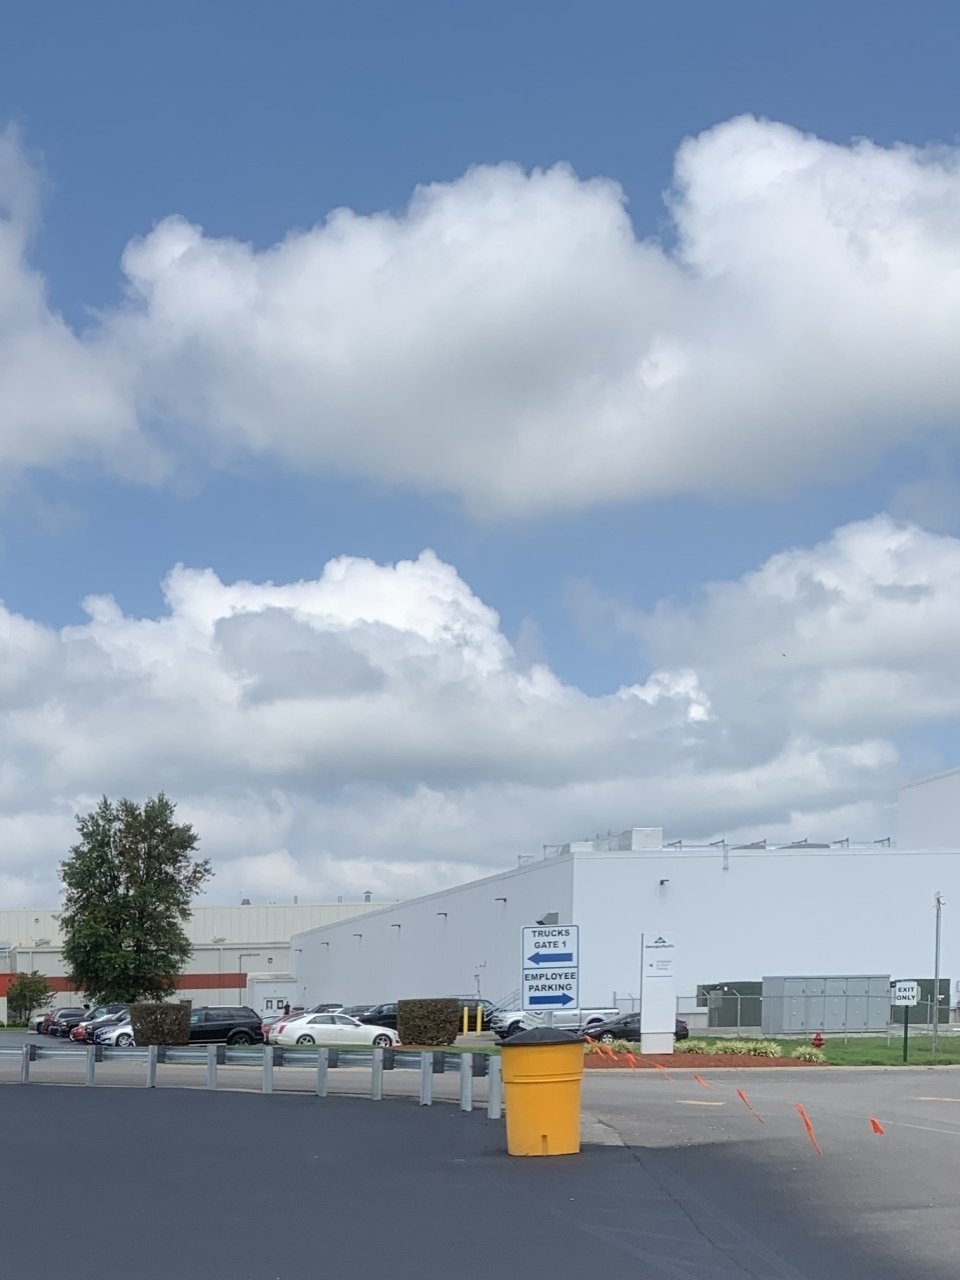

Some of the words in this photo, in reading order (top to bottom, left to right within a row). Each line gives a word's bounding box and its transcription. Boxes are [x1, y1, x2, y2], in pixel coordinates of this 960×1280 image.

[531, 929, 570, 938] TRUCKS
[534, 941, 559, 949] GATE
[562, 940, 567, 948] 1
[524, 972, 576, 981] EMPLOYEE
[528, 983, 572, 992] PARKING
